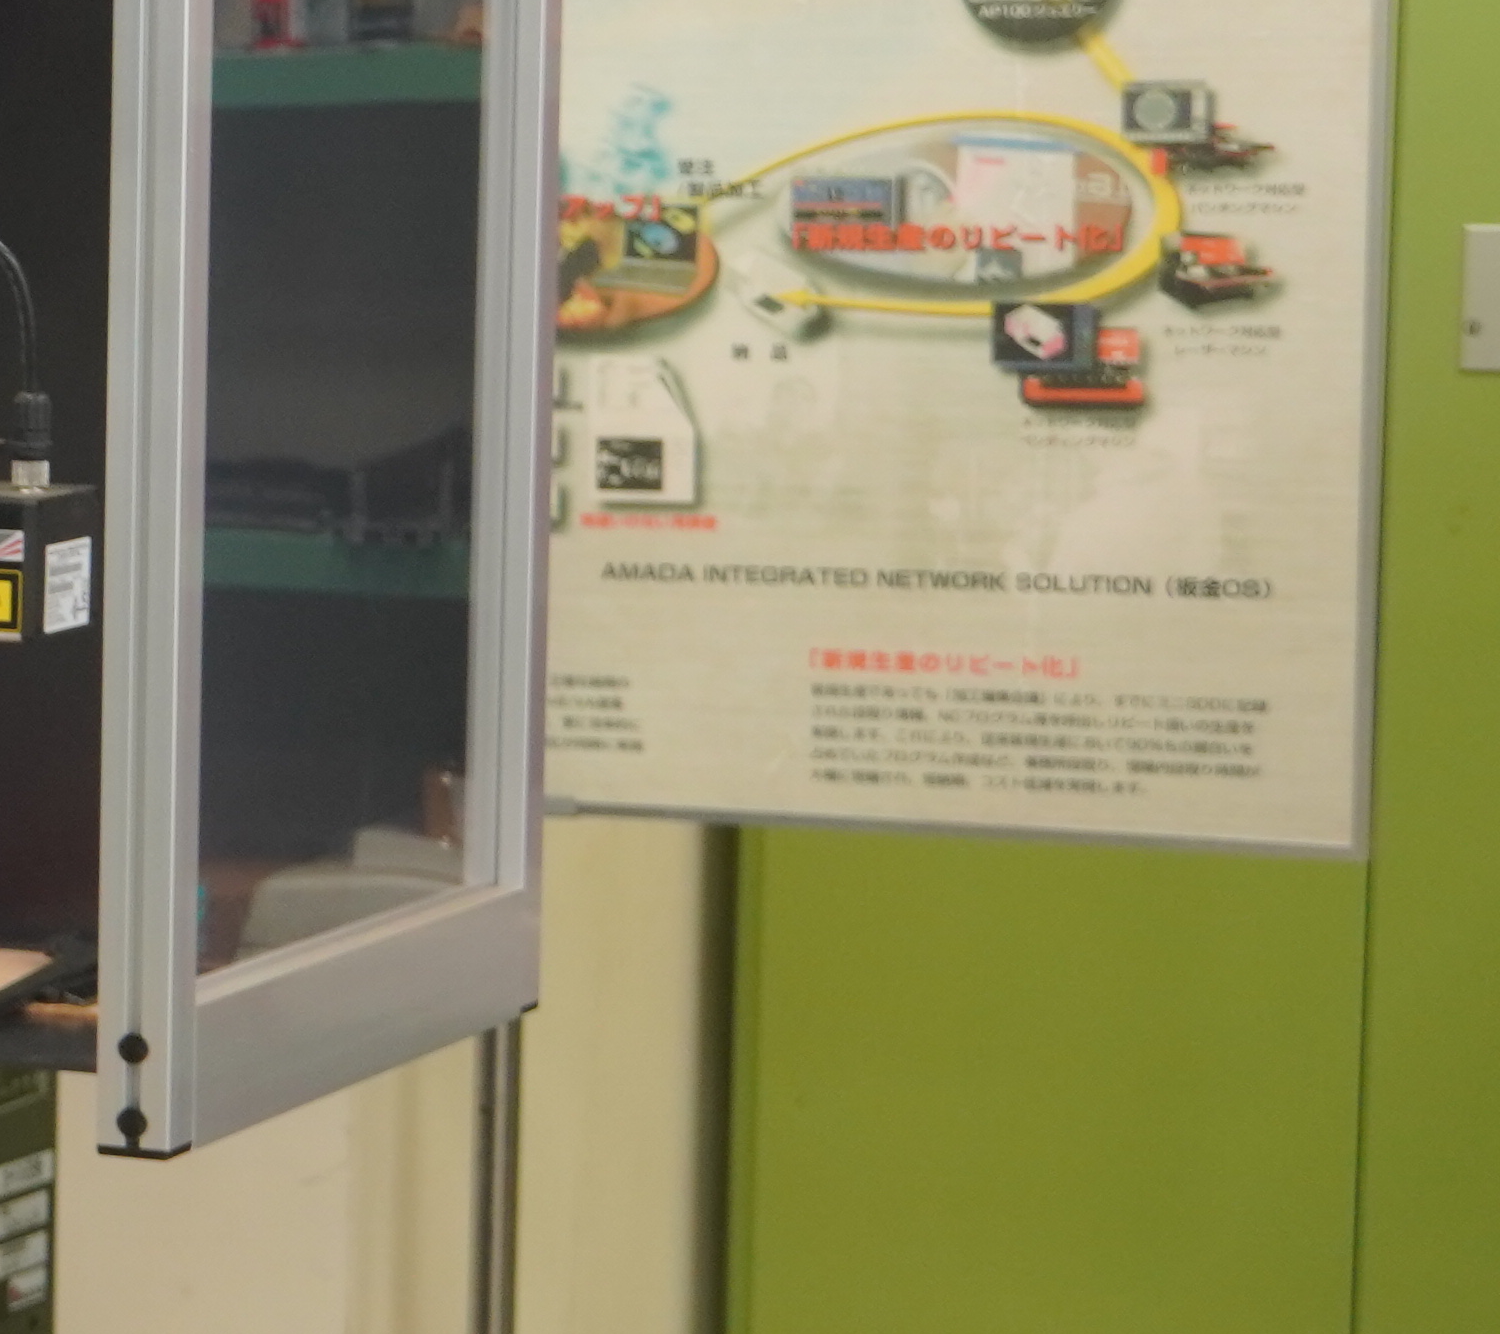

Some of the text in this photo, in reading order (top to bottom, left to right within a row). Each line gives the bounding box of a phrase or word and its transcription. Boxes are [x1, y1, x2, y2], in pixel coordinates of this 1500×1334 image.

[601, 561, 696, 583] AMADA
[702, 563, 868, 587] INTEGRATED
[875, 568, 1006, 592] NETWORK
[1015, 571, 1153, 596] SOLUTION
